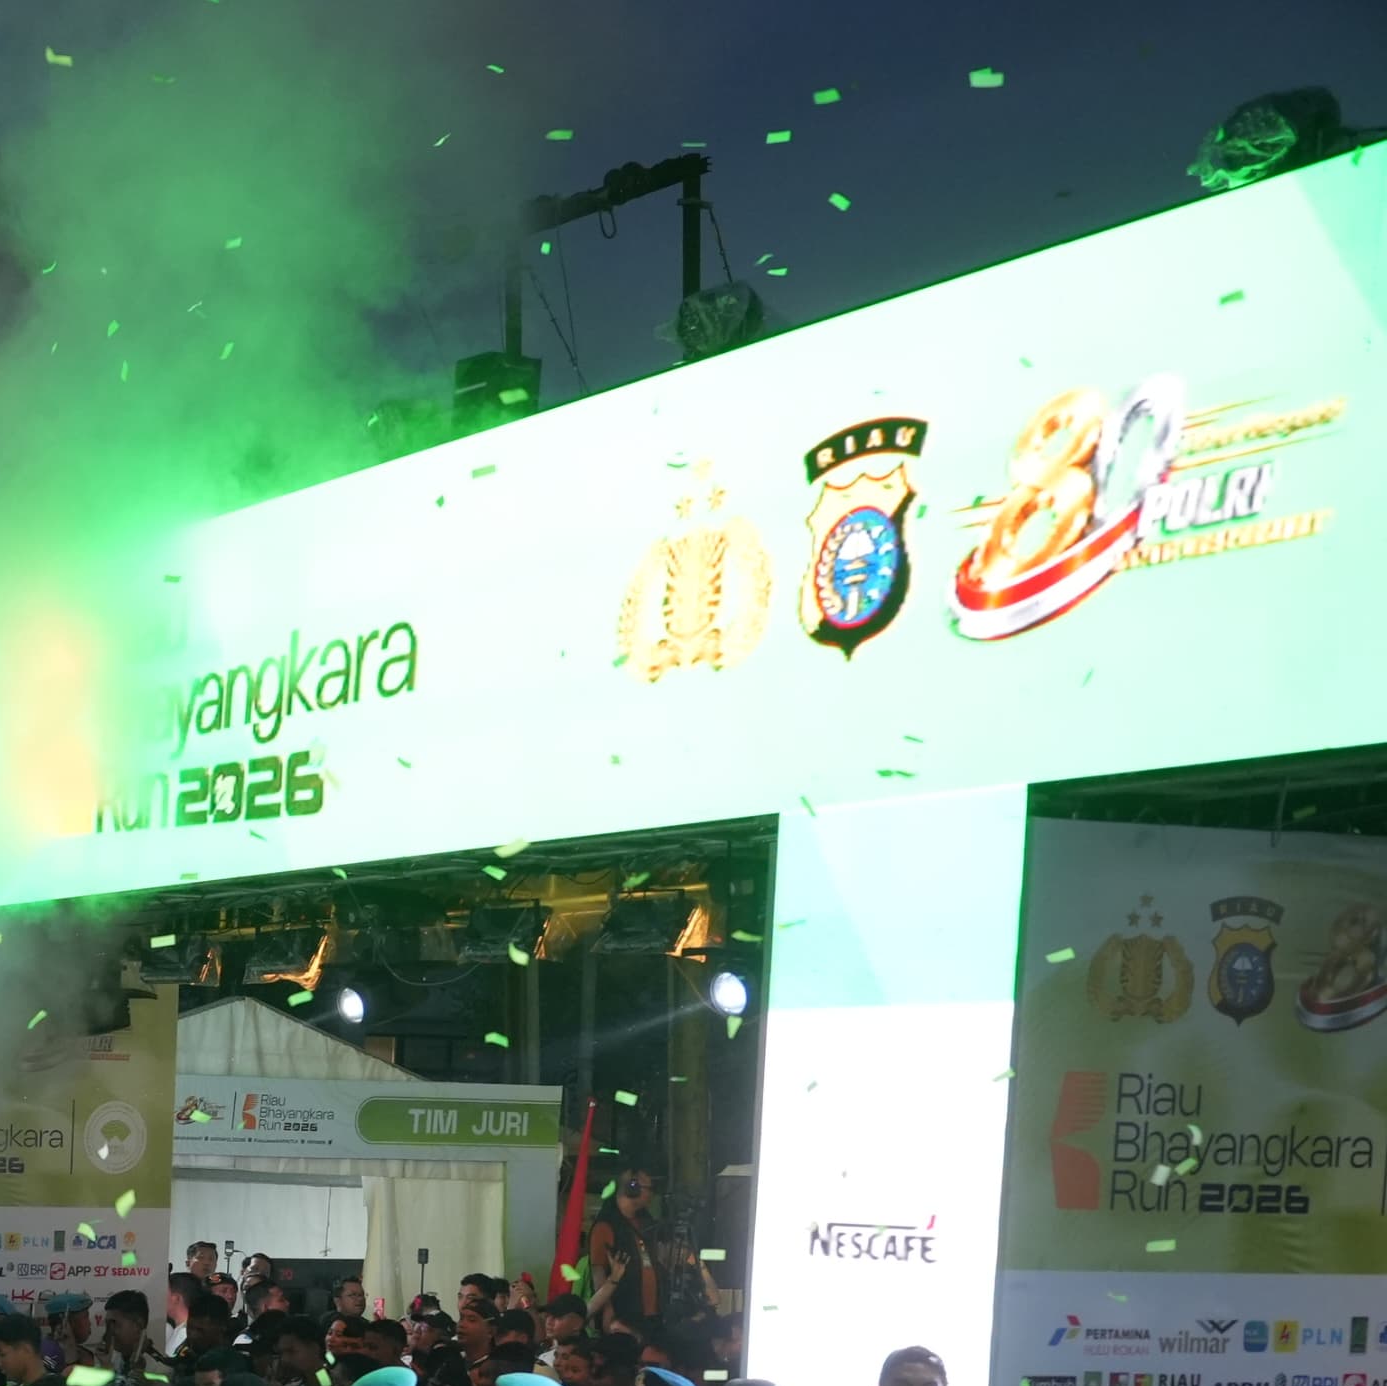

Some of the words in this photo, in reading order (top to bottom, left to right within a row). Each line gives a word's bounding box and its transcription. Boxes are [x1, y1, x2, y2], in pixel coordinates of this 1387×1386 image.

[815, 424, 918, 470] RIAU
[175, 749, 325, 829] 2026
[260, 1094, 286, 1106] Riau
[1116, 1072, 1202, 1117] Riau
[259, 1107, 335, 1122] Bhayangkara
[258, 1119, 282, 1131] Run
[283, 1122, 318, 1132] 2026
[408, 1108, 458, 1135] TIM
[471, 1110, 530, 1137] JURI
[1114, 1120, 1374, 1177] Bhayangkara
[1110, 1168, 1187, 1213] Run
[1199, 1182, 1310, 1215] 2026
[23, 1236, 50, 1248] PLN
[87, 1235, 117, 1250] BCA
[30, 1264, 48, 1276] BRI
[67, 1266, 92, 1277] APP
[112, 1267, 151, 1277] SEDAYU
[1084, 1328, 1151, 1340] PERTAMINA
[1302, 1328, 1344, 1345] PLN
[1158, 1330, 1231, 1354] wilmar
